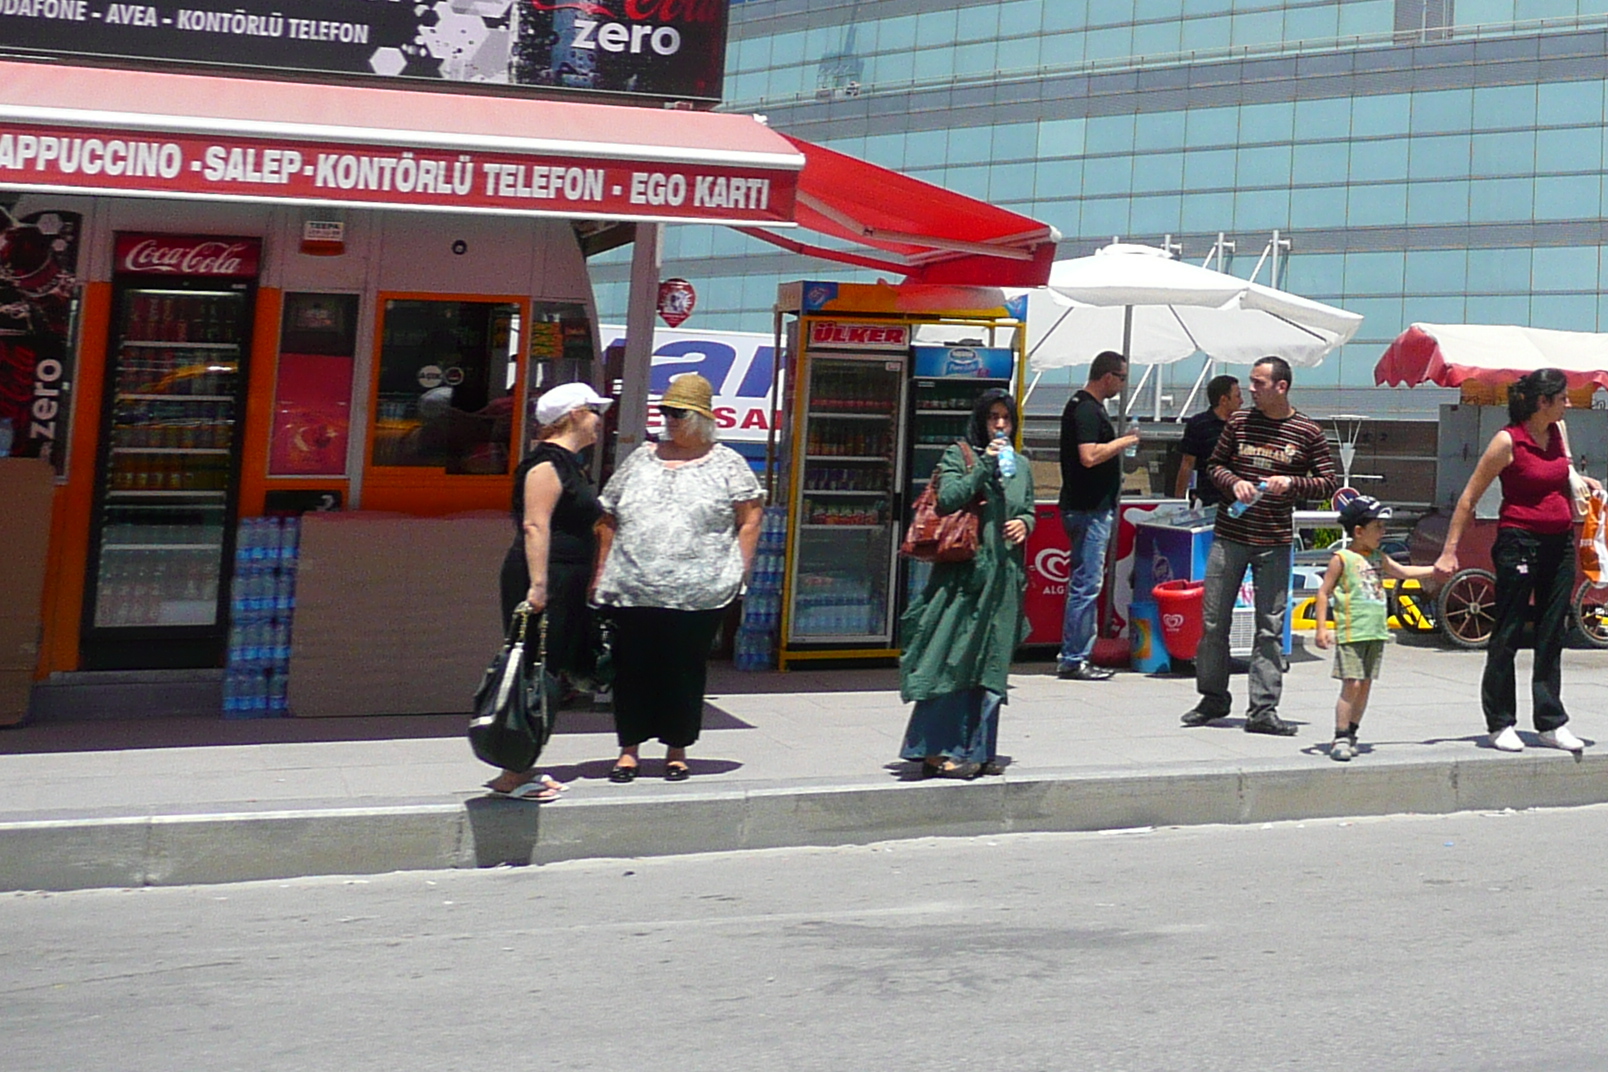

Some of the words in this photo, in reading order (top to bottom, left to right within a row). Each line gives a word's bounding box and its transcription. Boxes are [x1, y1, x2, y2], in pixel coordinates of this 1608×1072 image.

[106, 2, 158, 28] AVEA
[177, 8, 284, 38] KONTÖRLÜ
[288, 18, 369, 44] TELEFON
[571, 18, 681, 56] zero
[483, 162, 604, 201] TELEFON
[629, 172, 686, 206] EGO
[693, 175, 770, 210] KARTI
[125, 239, 247, 274] Coca-Cola
[813, 320, 905, 344] ÜLKER
[30, 358, 63, 439] zero
